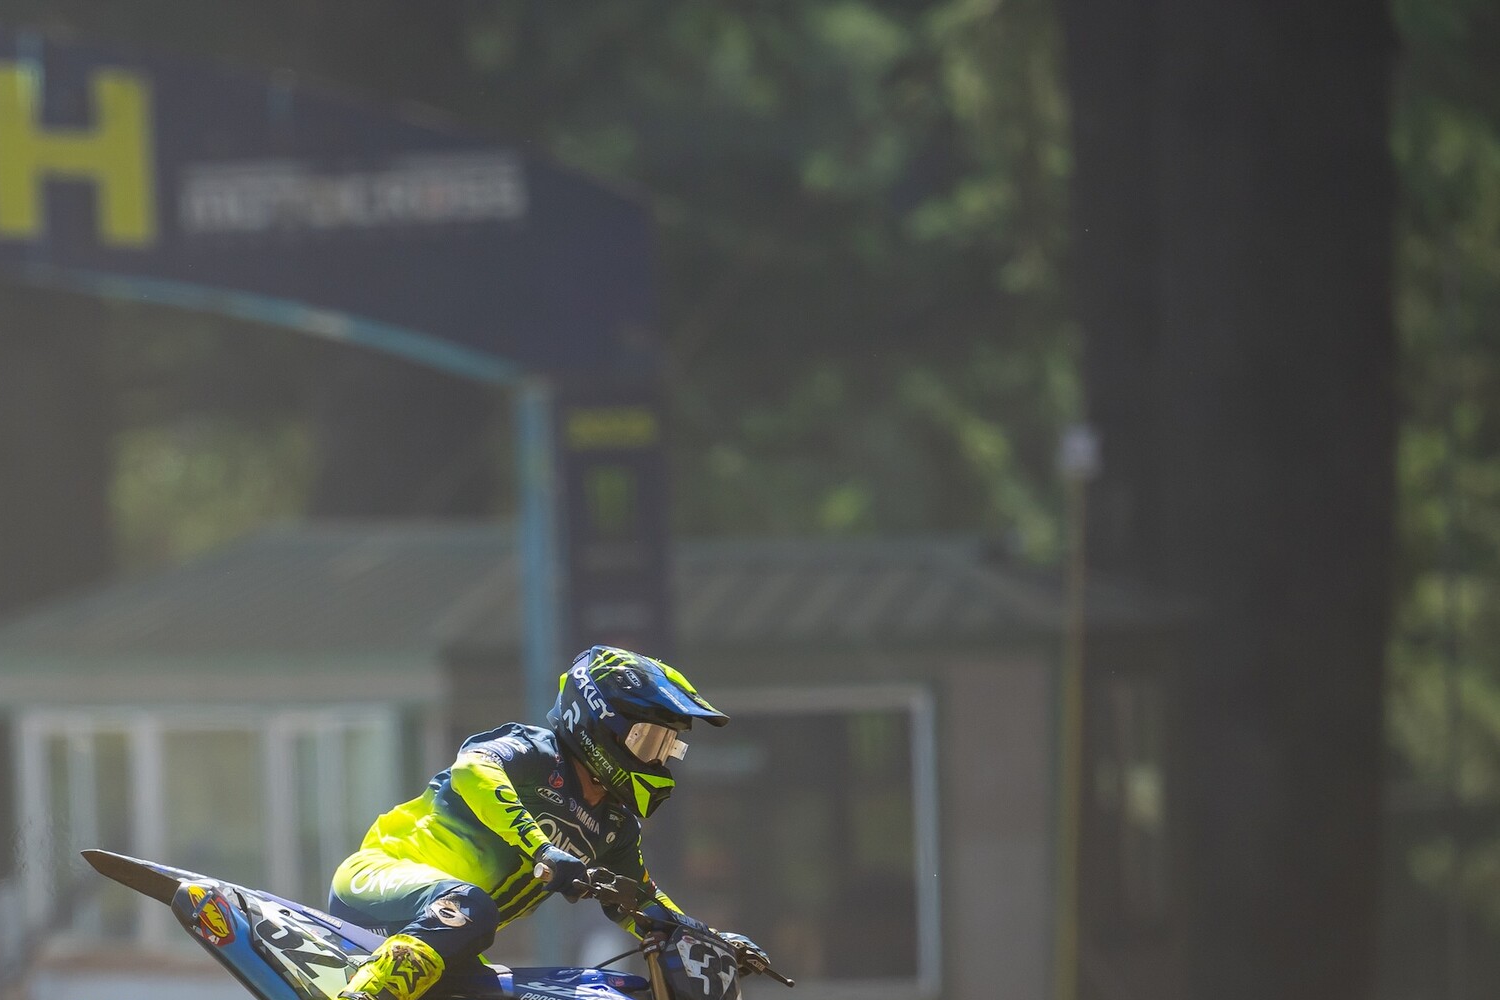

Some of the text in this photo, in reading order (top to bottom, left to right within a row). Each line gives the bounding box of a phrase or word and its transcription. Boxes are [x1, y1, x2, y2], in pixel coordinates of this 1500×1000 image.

[572, 666, 615, 720] OAKLEY
[579, 730, 614, 773] MONSTER
[575, 805, 600, 835] YAMAHA
